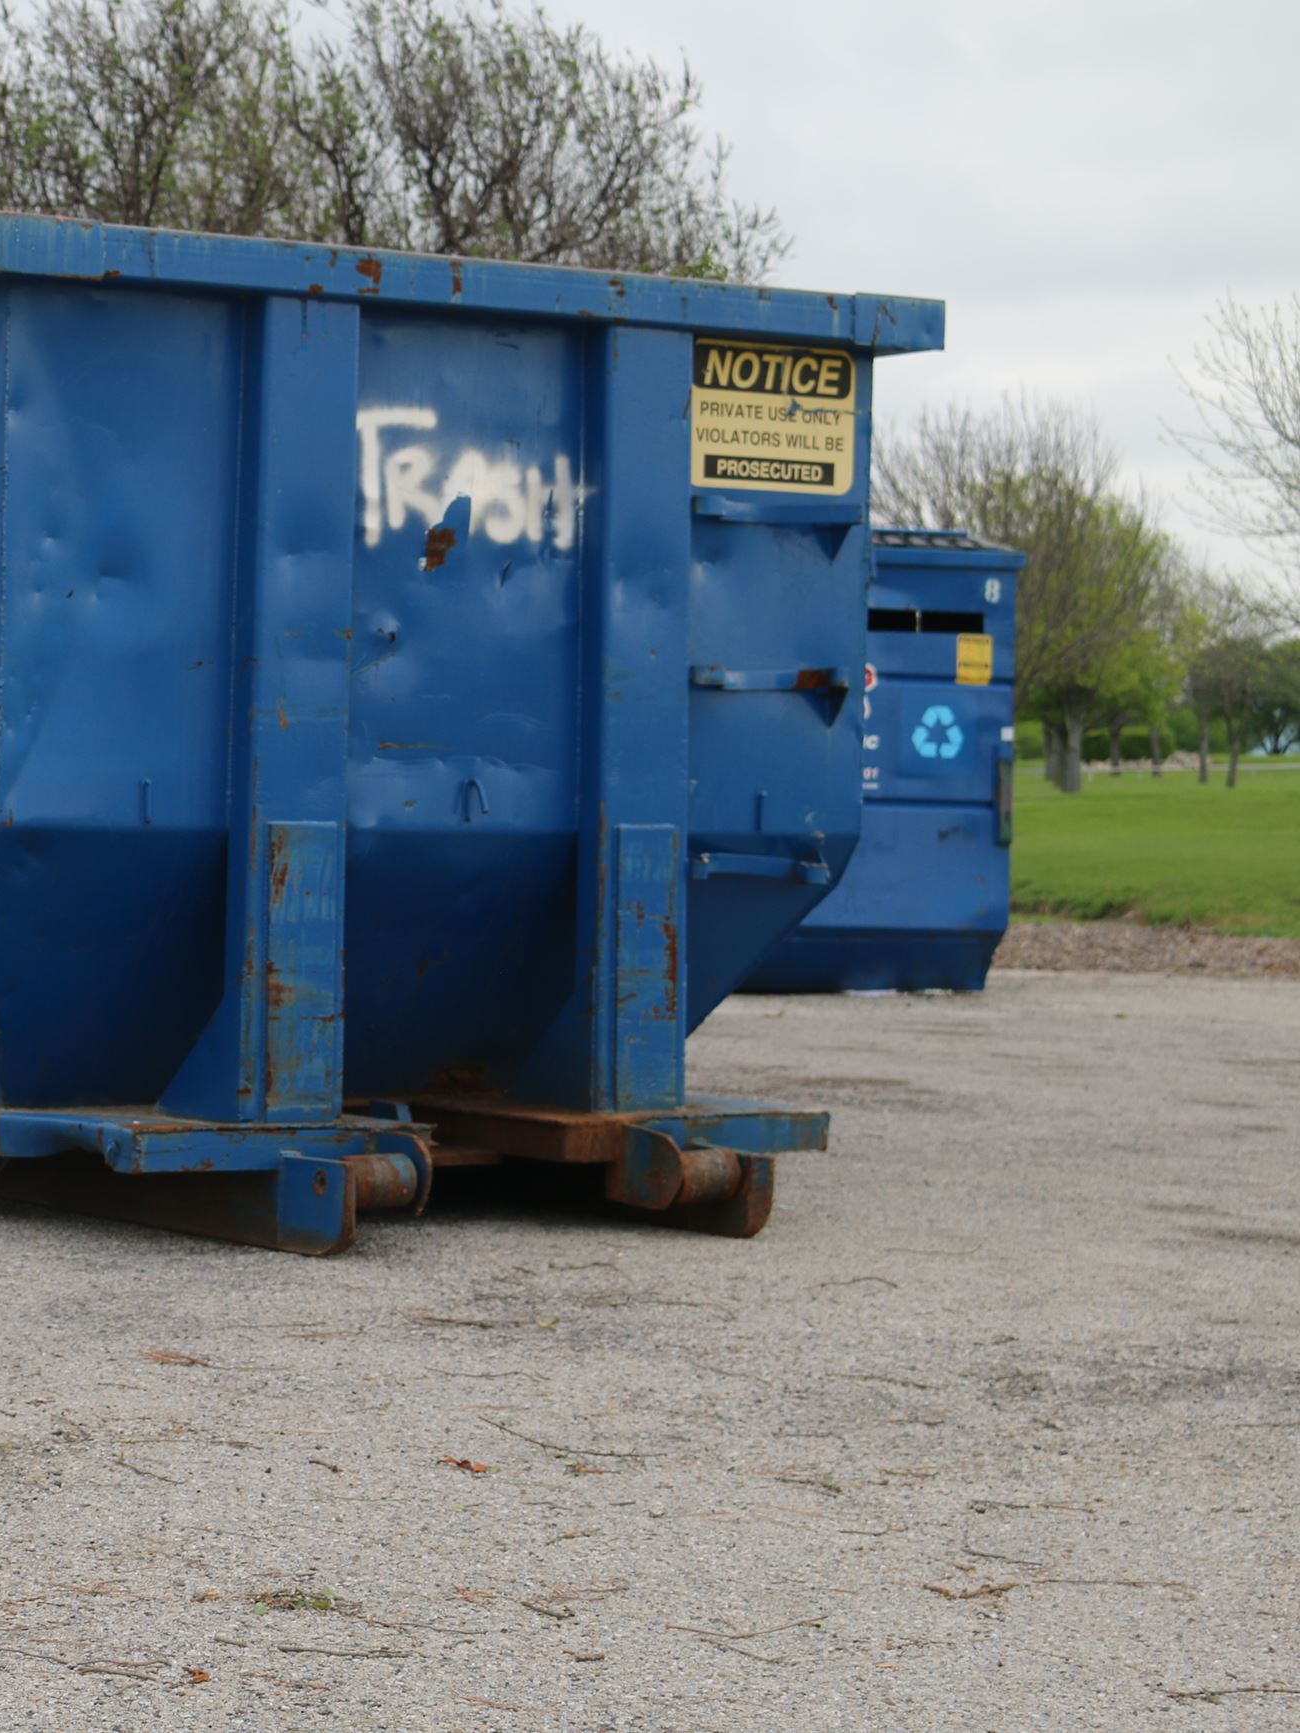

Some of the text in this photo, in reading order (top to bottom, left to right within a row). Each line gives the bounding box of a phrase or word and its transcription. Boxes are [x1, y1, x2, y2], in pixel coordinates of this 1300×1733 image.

[704, 350, 843, 395] NOTICE
[700, 401, 763, 420] PRIVATE
[802, 409, 841, 426] ONLY
[696, 427, 844, 452] VIOLATORS WILL BE
[356, 407, 580, 550] TRASH
[716, 459, 823, 482] PROSECUTED
